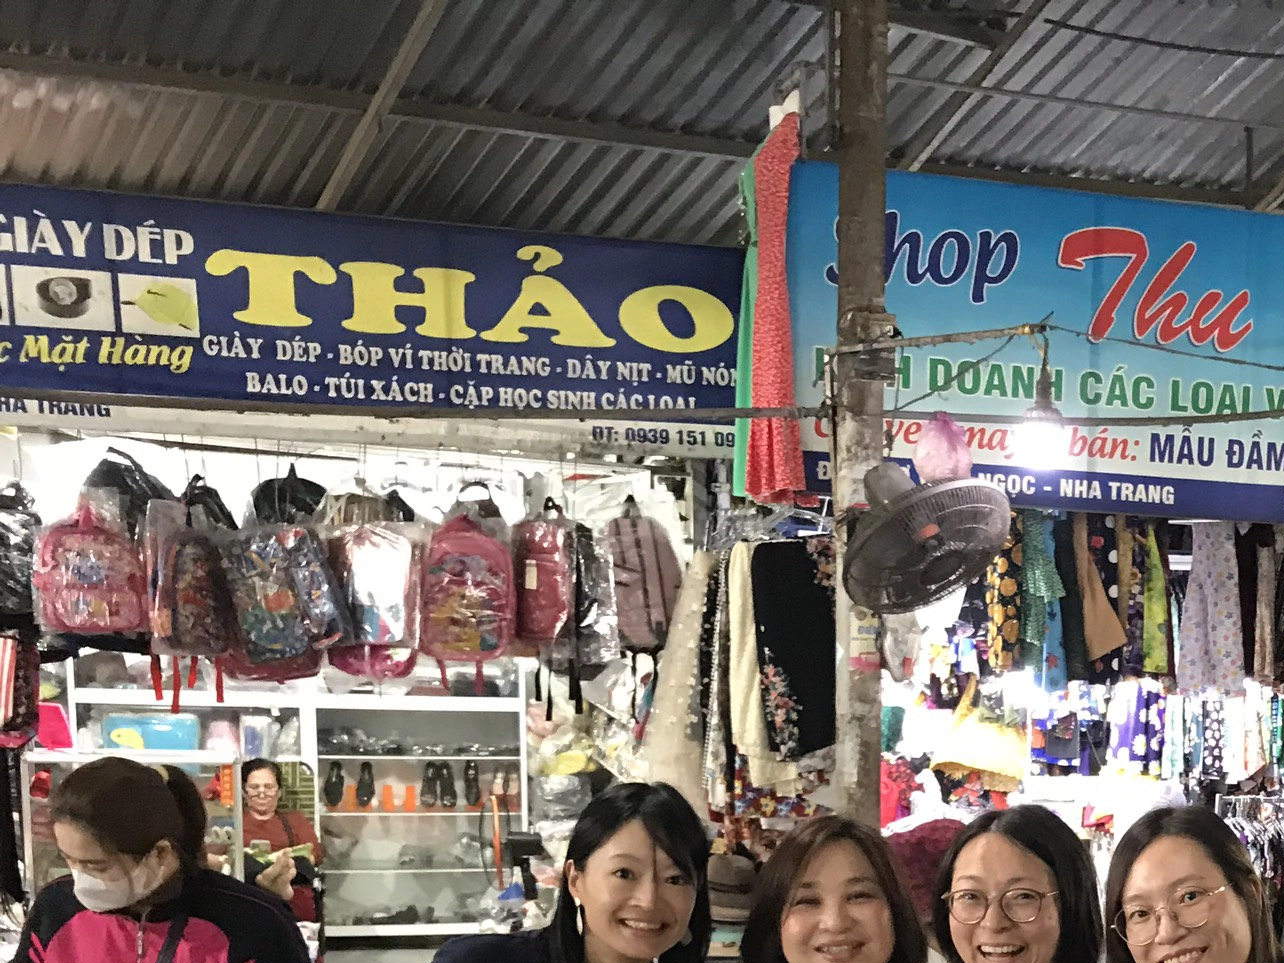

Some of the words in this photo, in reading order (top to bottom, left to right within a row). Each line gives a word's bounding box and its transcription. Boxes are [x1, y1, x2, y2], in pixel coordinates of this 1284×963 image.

[103, 219, 194, 264] DÉP
[204, 245, 735, 353] THẢO
[824, 209, 1020, 304] hop
[1057, 226, 1253, 354] Thu
[19, 334, 90, 372] Mặt
[98, 335, 194, 374] Hàng
[203, 331, 263, 359] GIÀY
[276, 335, 322, 362] DÉP
[338, 340, 383, 366] BÓP
[388, 343, 414, 369] VÍ
[418, 346, 472, 372] THỜI
[477, 353, 551, 377] TRANG
[566, 354, 611, 380] DÂY
[616, 361, 652, 386] NỊT
[666, 360, 696, 385] MŨ
[246, 372, 308, 396] BALO
[325, 372, 365, 399] TÚI
[370, 375, 434, 403] XÁCH
[450, 380, 493, 409] CẶP
[498, 387, 542, 410] HỌC
[547, 390, 596, 410] SINH
[601, 388, 643, 410] CÁC
[1079, 369, 1154, 411] CÁC
[625, 427, 670, 445] 0939
[676, 430, 706, 446] 151
[1068, 427, 1141, 463] bán:
[1150, 424, 1215, 467] MẪU
[1060, 479, 1102, 500] NHA
[1109, 481, 1175, 505] TRANG
